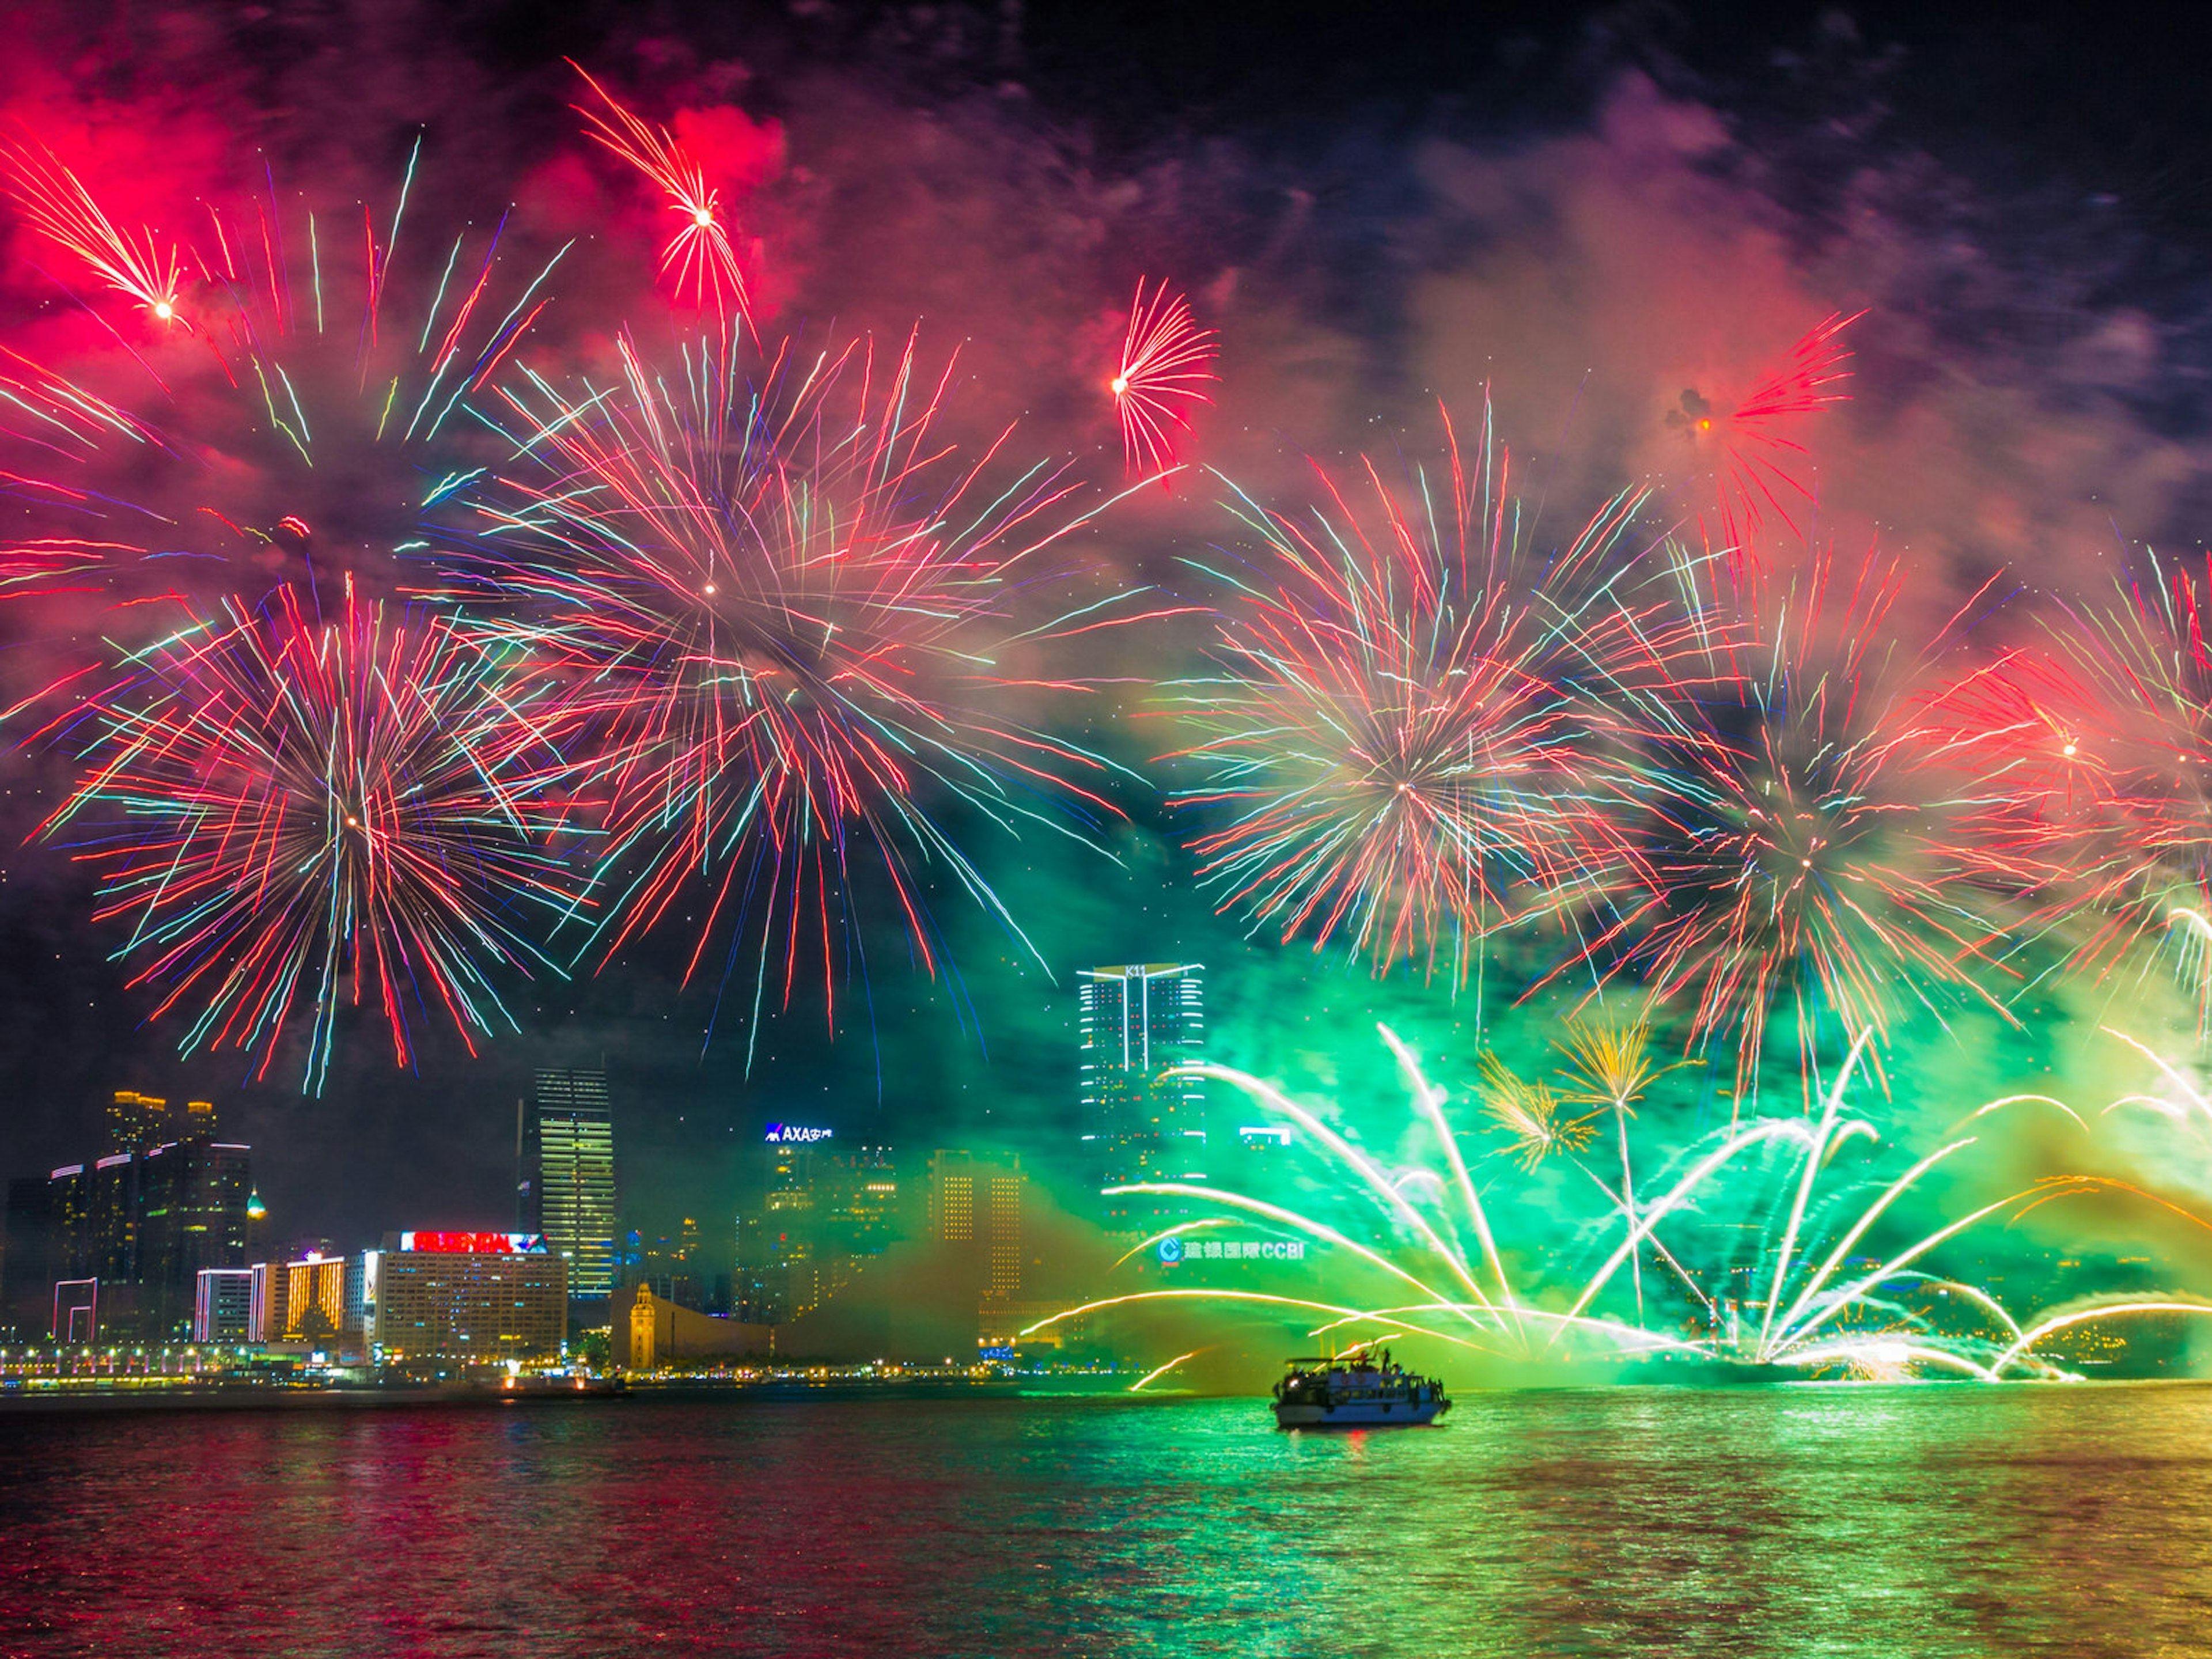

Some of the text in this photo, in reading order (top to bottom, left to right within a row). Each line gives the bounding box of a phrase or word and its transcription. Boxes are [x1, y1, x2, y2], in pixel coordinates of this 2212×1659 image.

[1125, 965, 1145, 977] K11
[783, 1126, 813, 1142] AXA
[1262, 1241, 1304, 1260] CCBI
